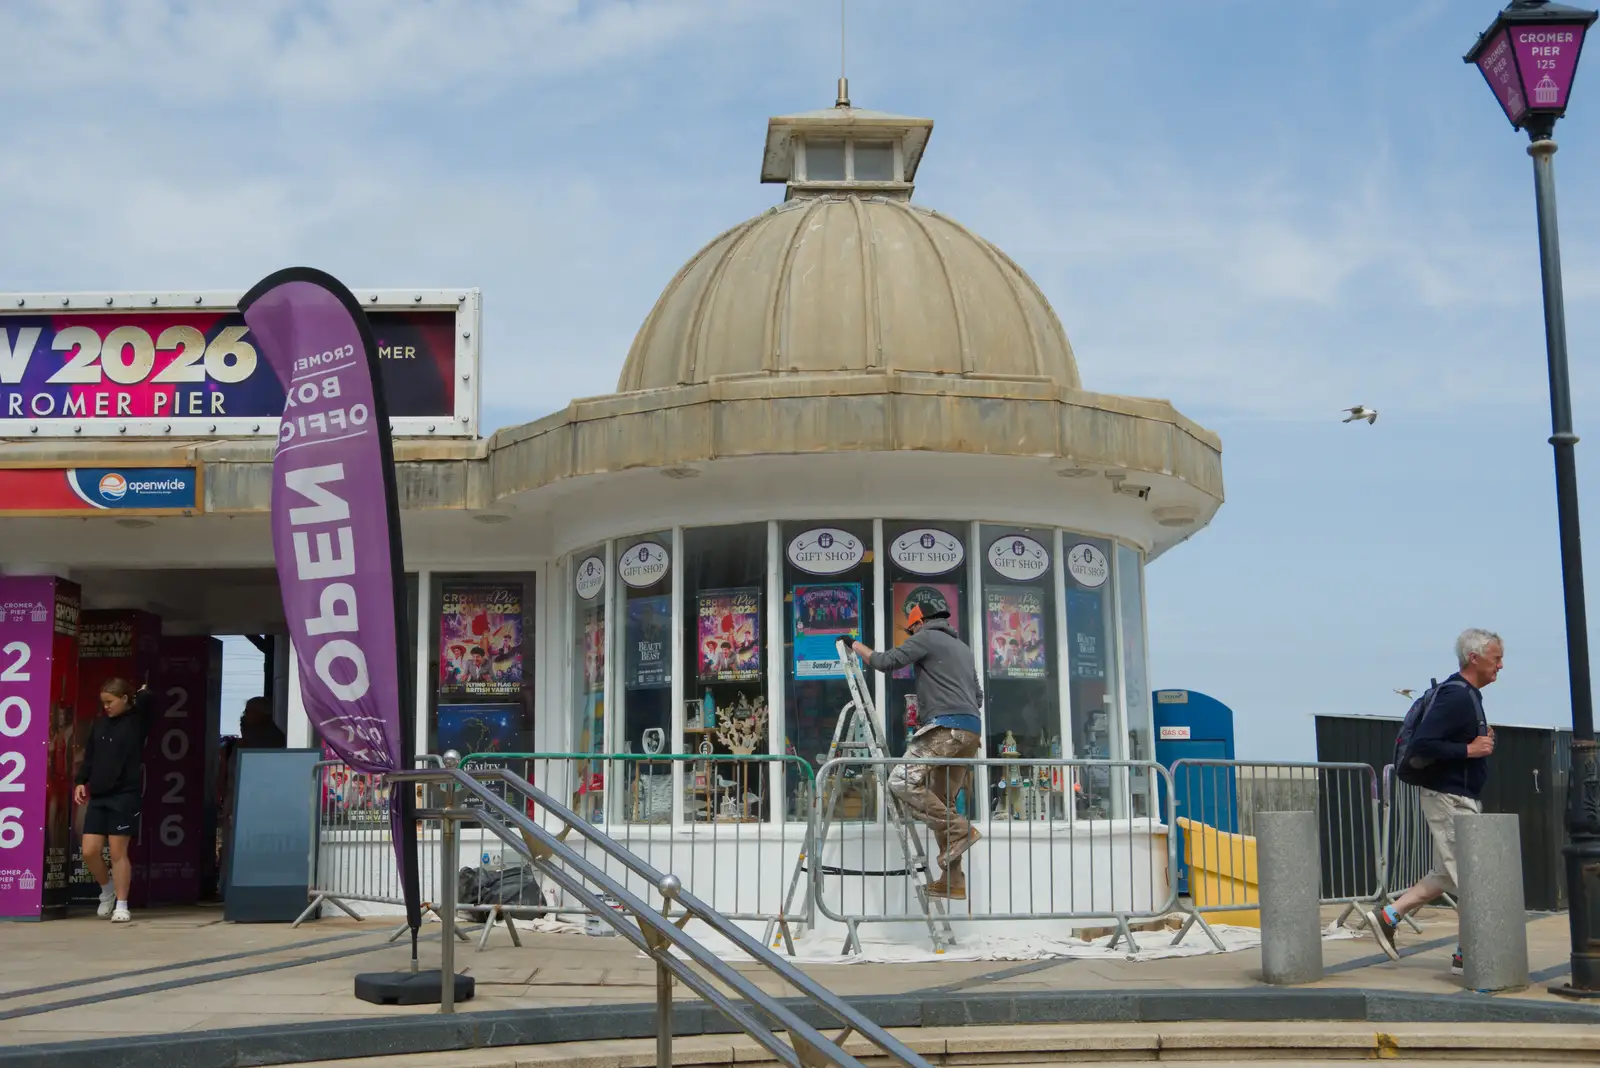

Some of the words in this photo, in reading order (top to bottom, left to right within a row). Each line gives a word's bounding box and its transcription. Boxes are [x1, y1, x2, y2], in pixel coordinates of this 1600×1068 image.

[1520, 33, 1573, 42] CROMER
[1483, 40, 1508, 70] CROMER
[1531, 46, 1560, 56] PIER
[1493, 58, 1508, 77] PIER
[1537, 60, 1556, 69] 125
[45, 325, 257, 384] 2026
[378, 346, 416, 359] MER
[0, 391, 132, 416] ROMER
[154, 391, 226, 415] PIER
[129, 479, 185, 493] openwide
[796, 552, 823, 562] GIFT
[825, 551, 856, 561] SHOP
[899, 552, 925, 562] GIFT
[927, 552, 957, 562] SHOP
[995, 558, 1017, 568] GIFT
[1018, 559, 1043, 570] SHOP
[624, 567, 641, 577] GIFT
[643, 563, 664, 574] SHOP
[486, 603, 522, 614] 2026
[80, 631, 133, 646] SHOW
[638, 641, 662, 652] BEAUTY
[641, 651, 660, 661] BEAST
[812, 661, 832, 671] Sunday
